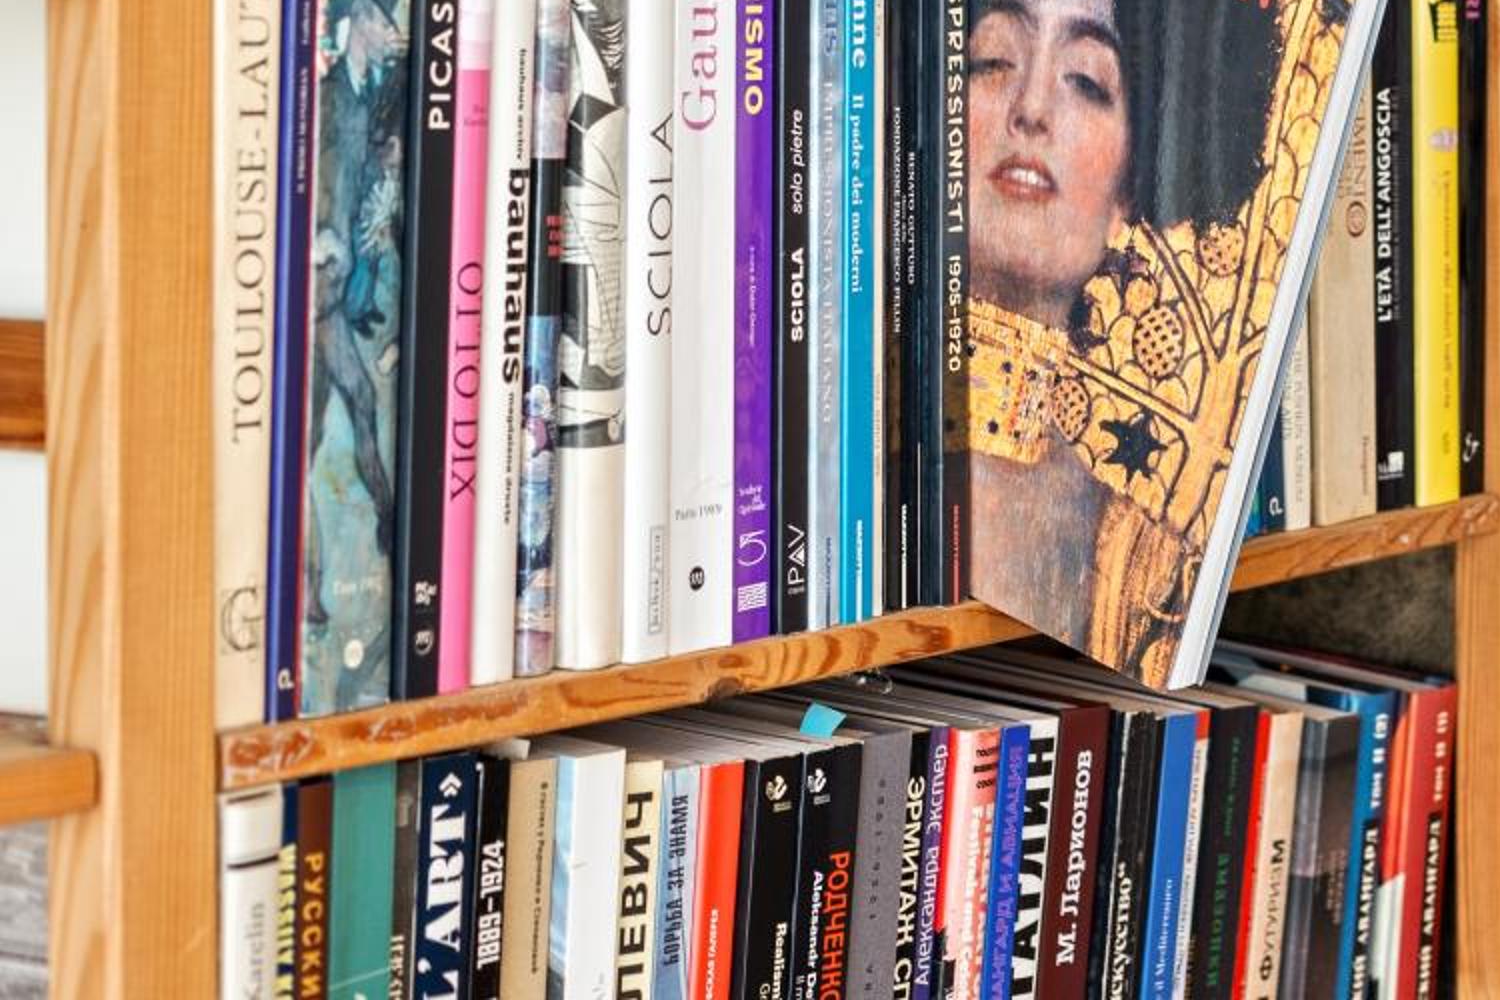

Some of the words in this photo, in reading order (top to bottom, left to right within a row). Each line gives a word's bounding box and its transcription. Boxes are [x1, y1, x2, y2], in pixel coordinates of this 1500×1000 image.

[516, 47, 528, 111] bauhaus
[851, 93, 865, 109] Il
[848, 114, 863, 170] padre
[892, 105, 901, 198] FONDAZIONE
[906, 150, 916, 212] RENATO
[1376, 87, 1391, 258] DELL'ANGOSCIA
[646, 111, 673, 336] SCIOLA
[789, 172, 803, 214] solo
[851, 175, 864, 205] dei
[502, 166, 530, 386] bauhaus
[850, 211, 863, 292] moderni
[891, 199, 901, 283] FRANCESCO
[453, 260, 482, 399] OTTO
[790, 247, 804, 341] SCIOLA
[892, 285, 901, 334] PELLIN
[947, 254, 962, 371] 1905-1920
[1375, 266, 1392, 321] L'ETÀ
[450, 419, 477, 500] DIX
[666, 794, 688, 858] ЗНАМЯ
[925, 743, 948, 834] Экстер
[892, 773, 925, 950] ЭРМИТАЖ
[1059, 749, 1092, 916] Ларионов
[666, 866, 684, 890] ЗА
[807, 870, 823, 968] Aleksandr
[913, 845, 939, 985] Александра
[1258, 838, 1285, 981] ФУТУРИЗМ
[1357, 828, 1378, 943] АВАНГАРД
[1423, 820, 1440, 934] АВАНГАРД
[661, 897, 682, 967] БОРЬБА
[706, 907, 719, 958] ГАЛЕРЕЯ
[1055, 922, 1077, 966] М.
